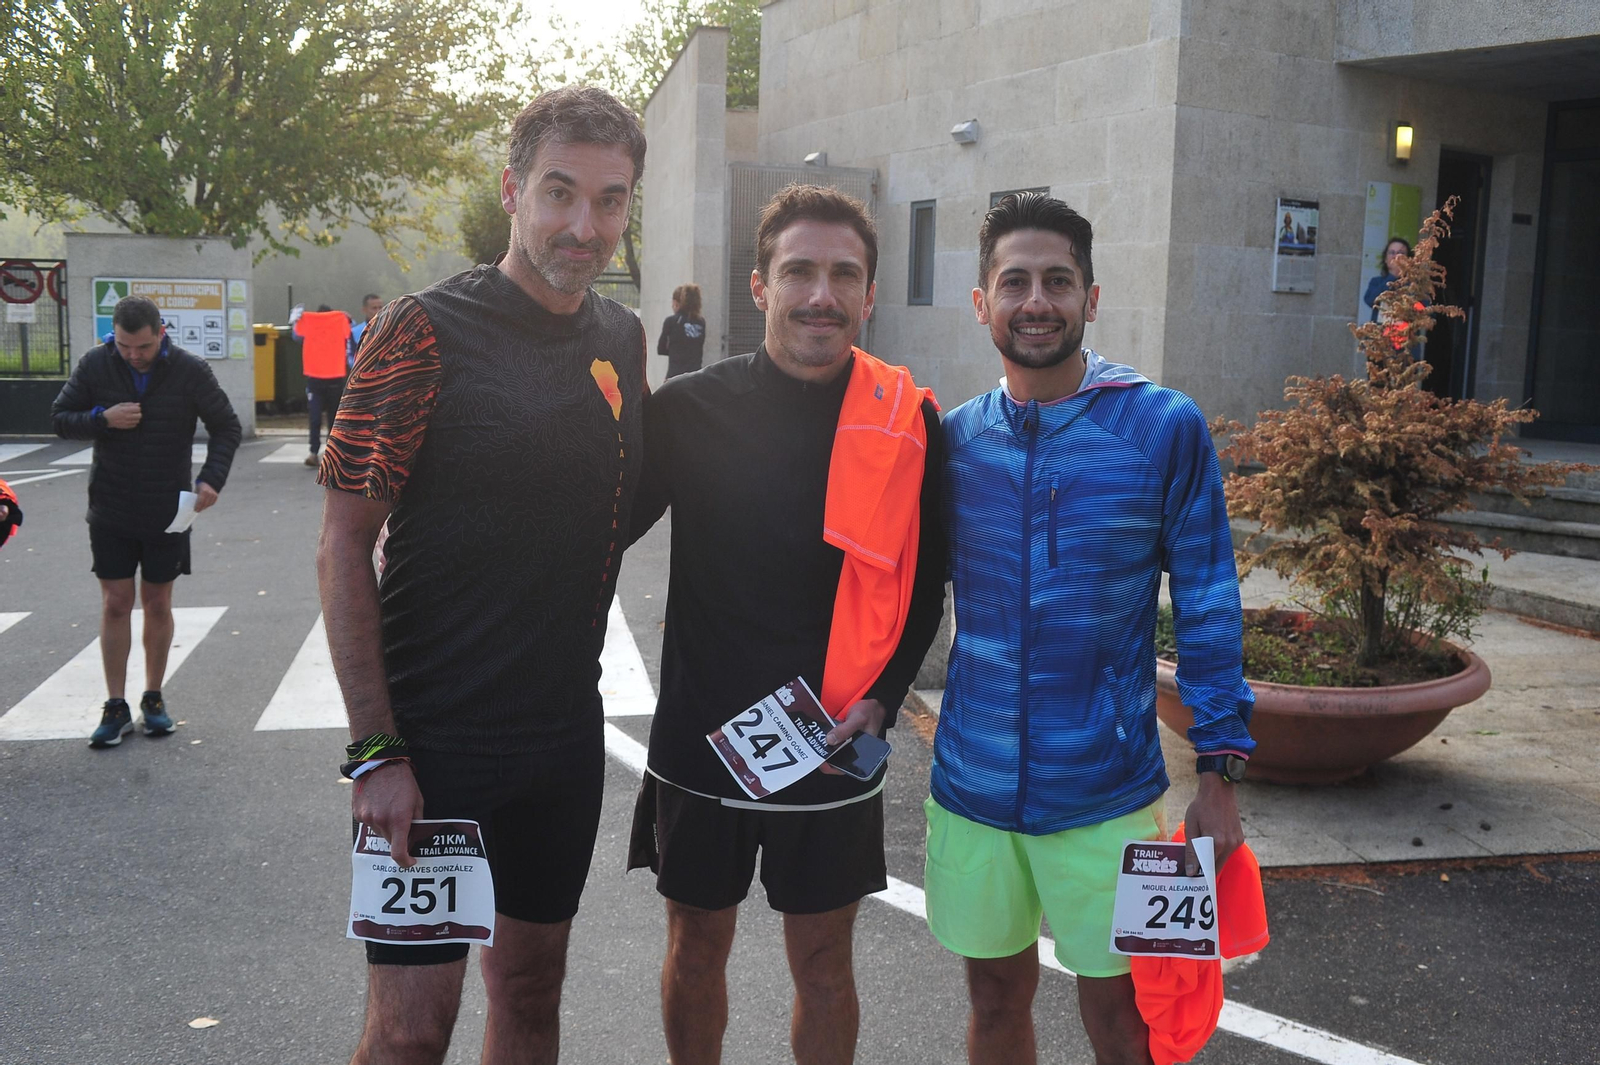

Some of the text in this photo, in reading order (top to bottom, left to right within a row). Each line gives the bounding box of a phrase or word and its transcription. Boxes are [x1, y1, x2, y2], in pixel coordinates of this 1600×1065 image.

[133, 283, 220, 296] CAMPING MUNICIPAL
[618, 432, 625, 458] LA
[794, 717, 808, 737] TRAIL
[730, 708, 799, 773] 247
[773, 716, 793, 742] CAMINO
[791, 741, 809, 761] GÓMEZ
[432, 834, 466, 846] 21KM
[419, 847, 478, 856] TRAIL ADVANCE
[1134, 849, 1159, 859] TRAIL
[372, 863, 474, 874] CARLOS CHAVES GONZÁLEZ
[1131, 857, 1178, 874] XURÉS
[381, 876, 457, 915] 251
[1142, 884, 1167, 892] MIGUEL
[1146, 895, 1214, 930] 249
